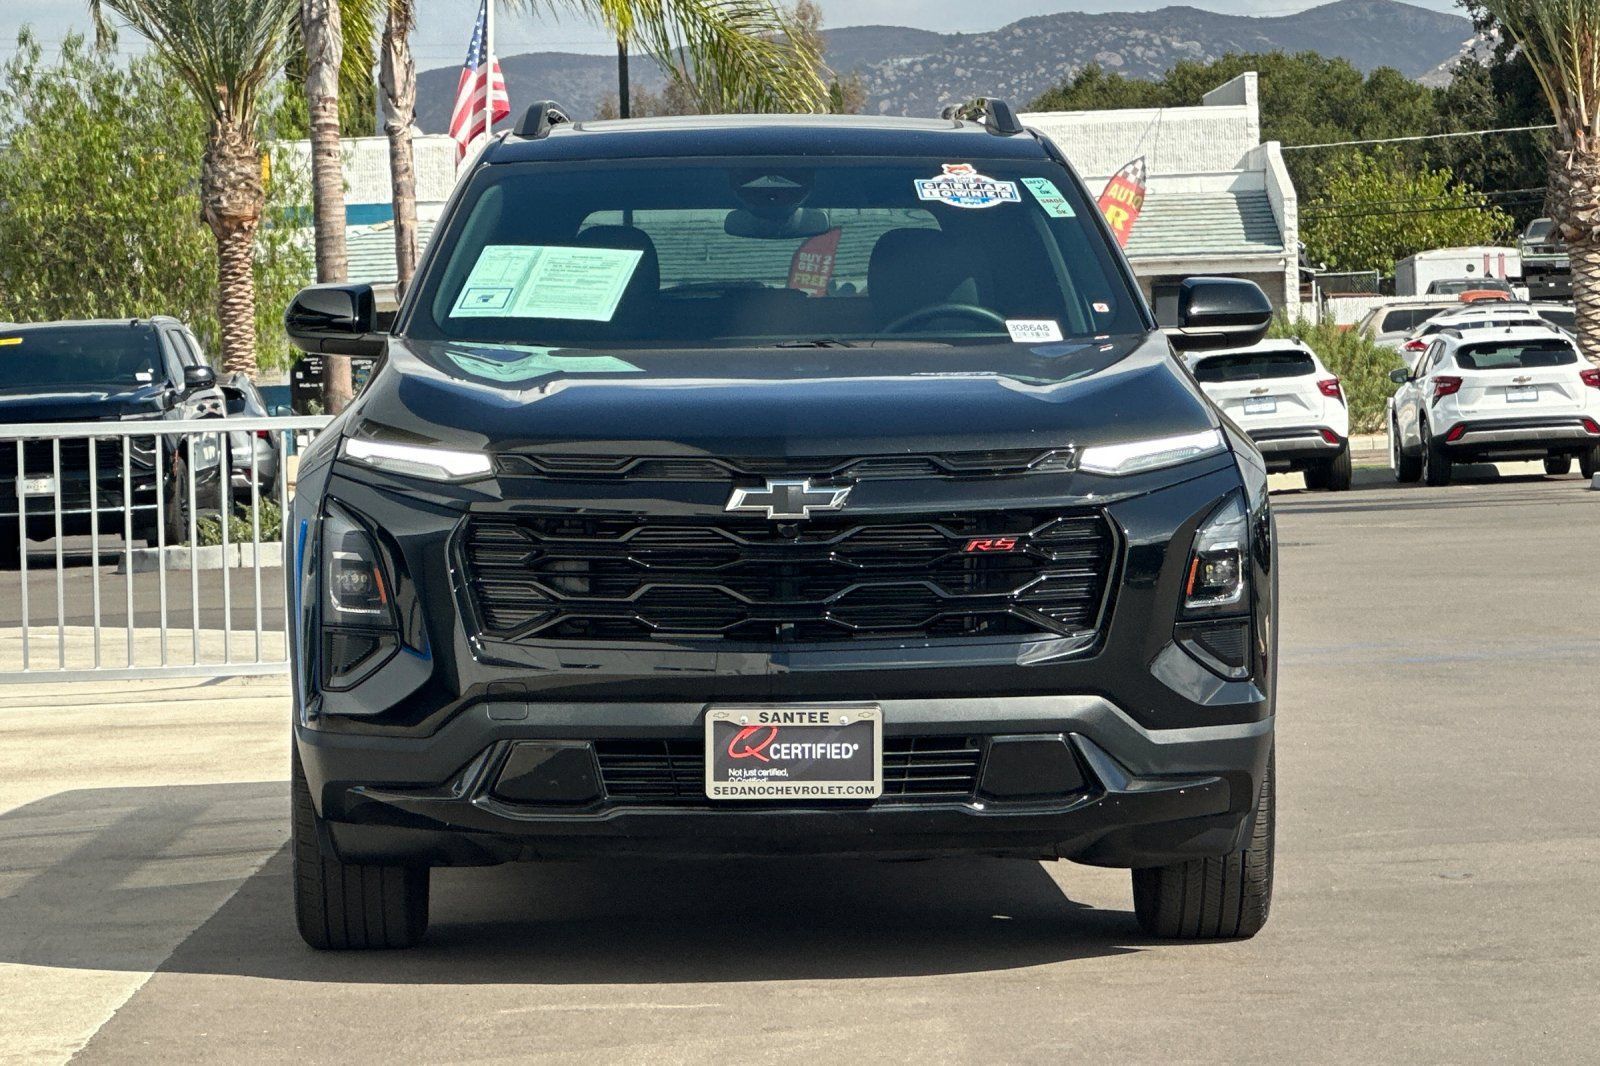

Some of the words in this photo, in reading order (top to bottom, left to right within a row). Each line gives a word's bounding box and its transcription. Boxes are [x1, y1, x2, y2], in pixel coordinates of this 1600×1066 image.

[923, 182, 1008, 191] CARFAX
[940, 190, 1013, 199] OWNER
[1107, 183, 1142, 210] AUTO
[800, 252, 822, 263] BUY
[799, 261, 820, 272] GET
[794, 272, 828, 288] FREE
[966, 539, 1016, 551] RS
[759, 711, 830, 724] SANTEE
[728, 768, 743, 777] Not
[743, 768, 757, 778] just
[713, 785, 875, 796] SEDANOCHEVROLET.COM
